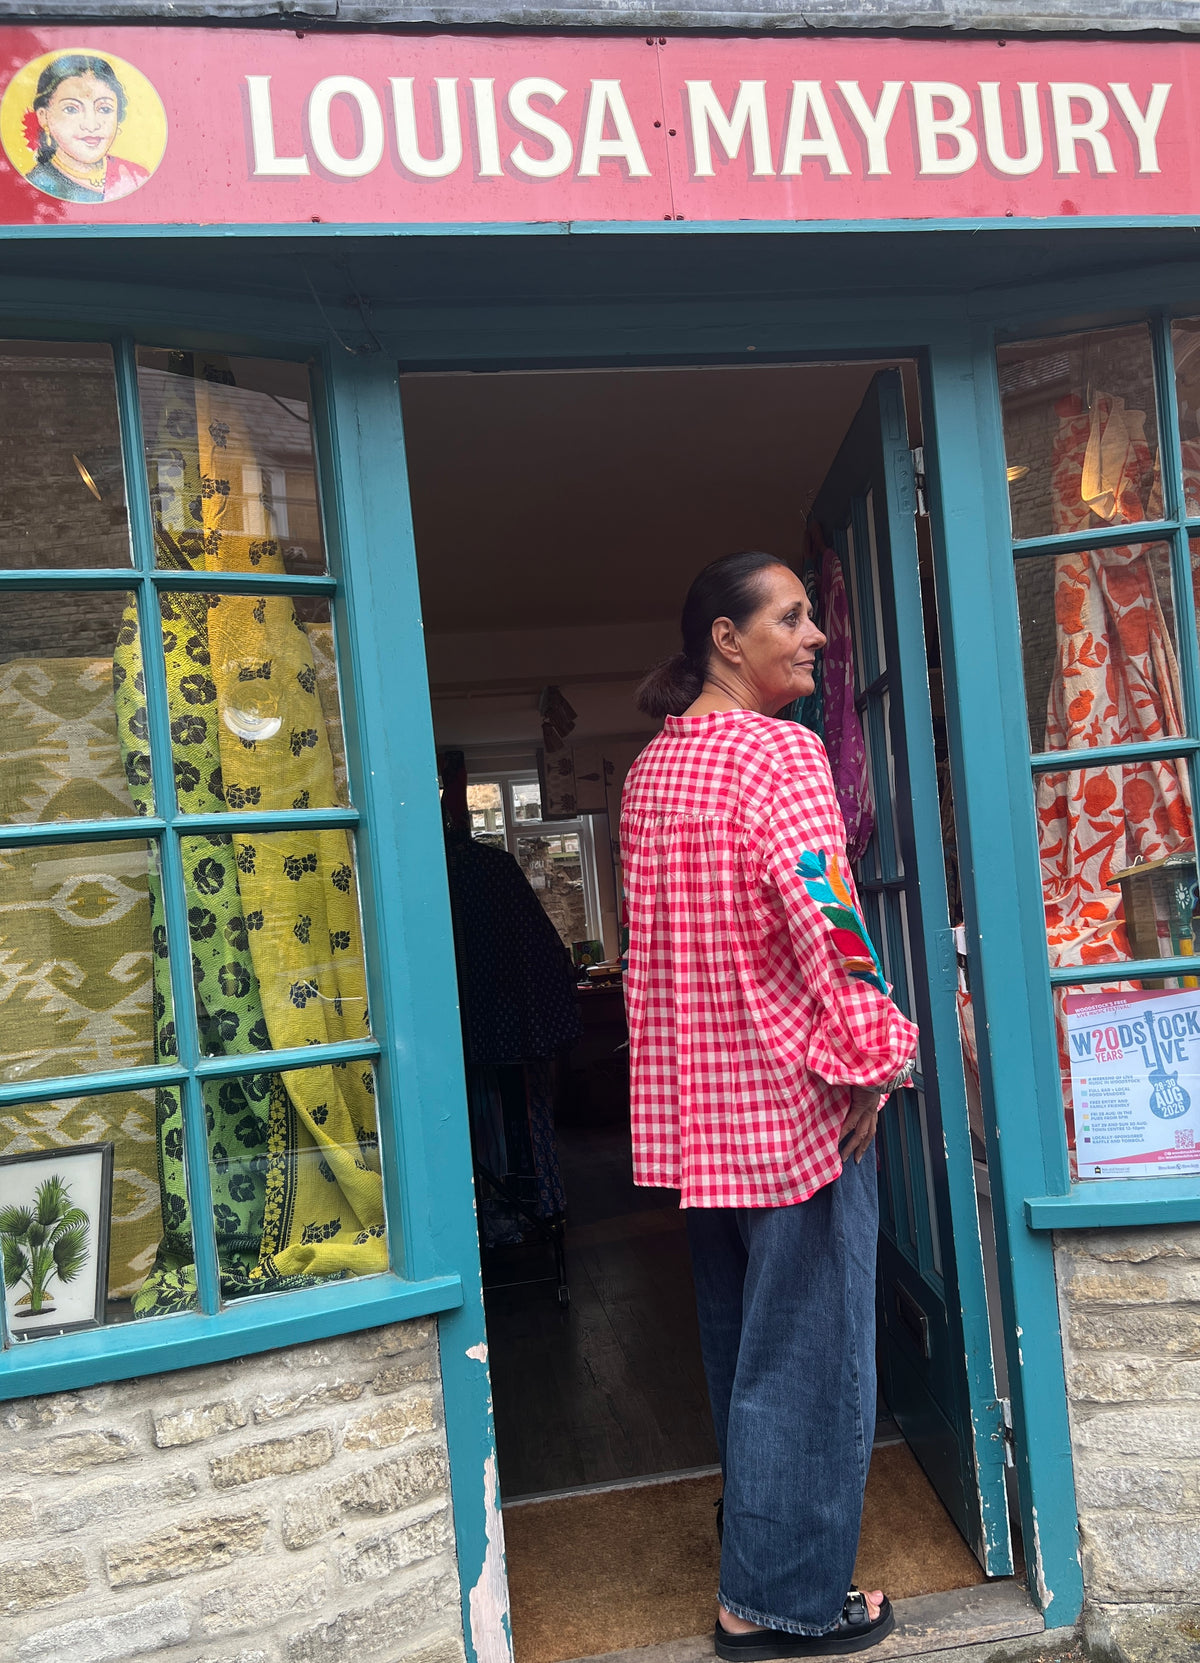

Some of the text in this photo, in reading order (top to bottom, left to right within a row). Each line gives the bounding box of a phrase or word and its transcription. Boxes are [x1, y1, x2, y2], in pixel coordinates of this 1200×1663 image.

[245, 75, 1173, 178] LOUISA MAYBURY
[1095, 1049, 1124, 1064] YEARS
[1154, 1078, 1176, 1091] 28-30
[1155, 1086, 1184, 1108] AUG
[1162, 1102, 1185, 1118] 2026
